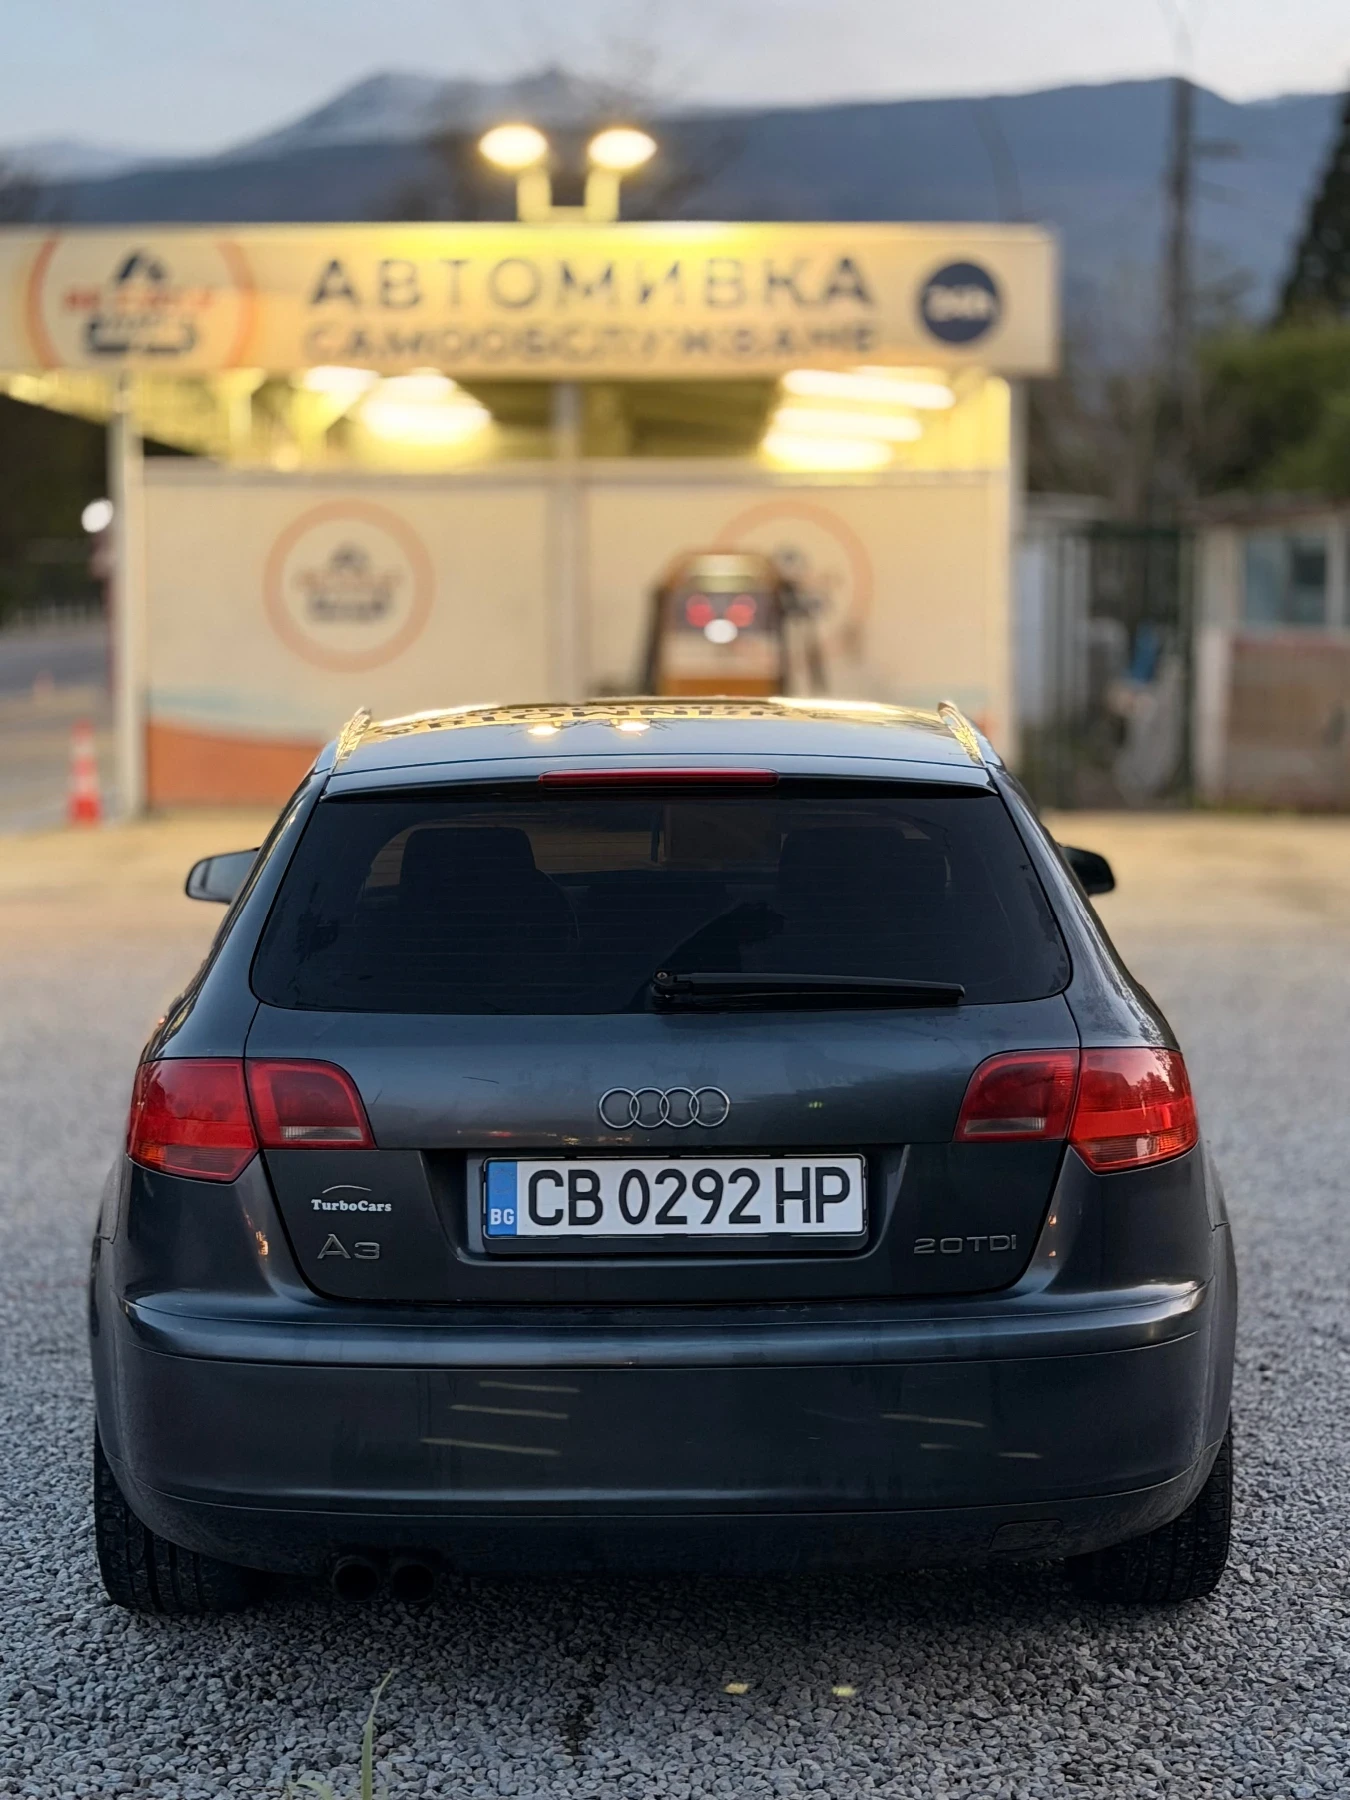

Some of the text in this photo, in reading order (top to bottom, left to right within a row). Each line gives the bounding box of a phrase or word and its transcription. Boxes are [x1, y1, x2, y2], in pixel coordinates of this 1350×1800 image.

[308, 258, 872, 309] АВТОМИВКА
[311, 1199, 392, 1212] TurboCars
[528, 1166, 850, 1226] CB 0292 HP
[490, 1208, 515, 1225] BG
[317, 1233, 381, 1260] A3
